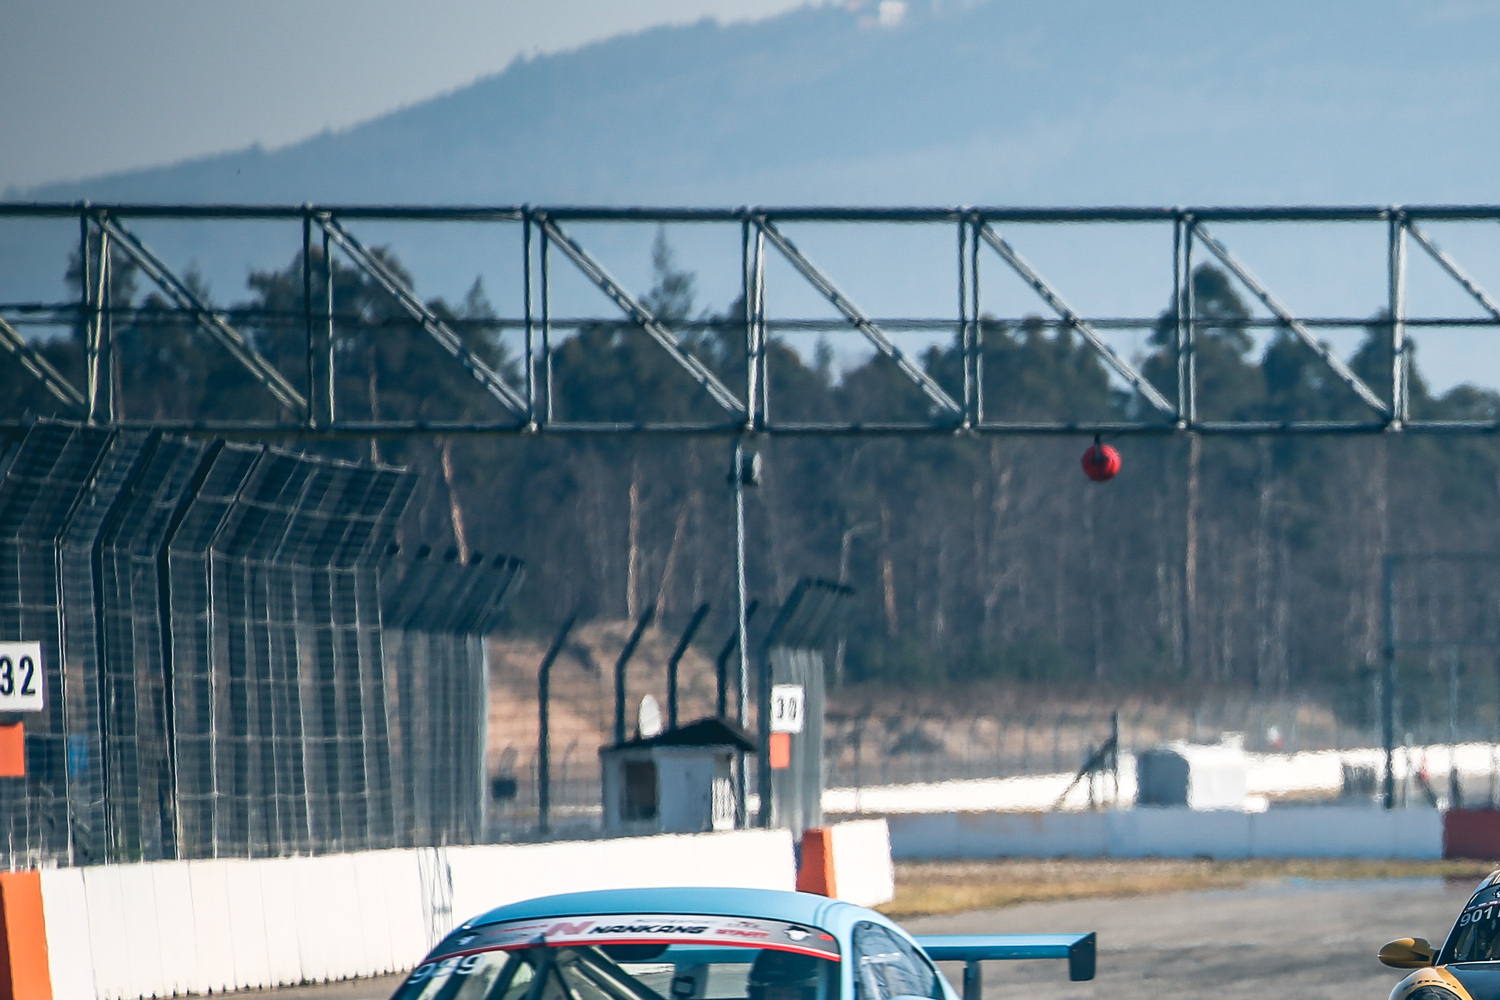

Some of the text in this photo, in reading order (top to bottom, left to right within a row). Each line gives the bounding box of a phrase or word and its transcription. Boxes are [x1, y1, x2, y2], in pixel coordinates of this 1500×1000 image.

[0, 655, 36, 696] 32
[1459, 906, 1493, 927] 901
[588, 924, 709, 934] NANKANG
